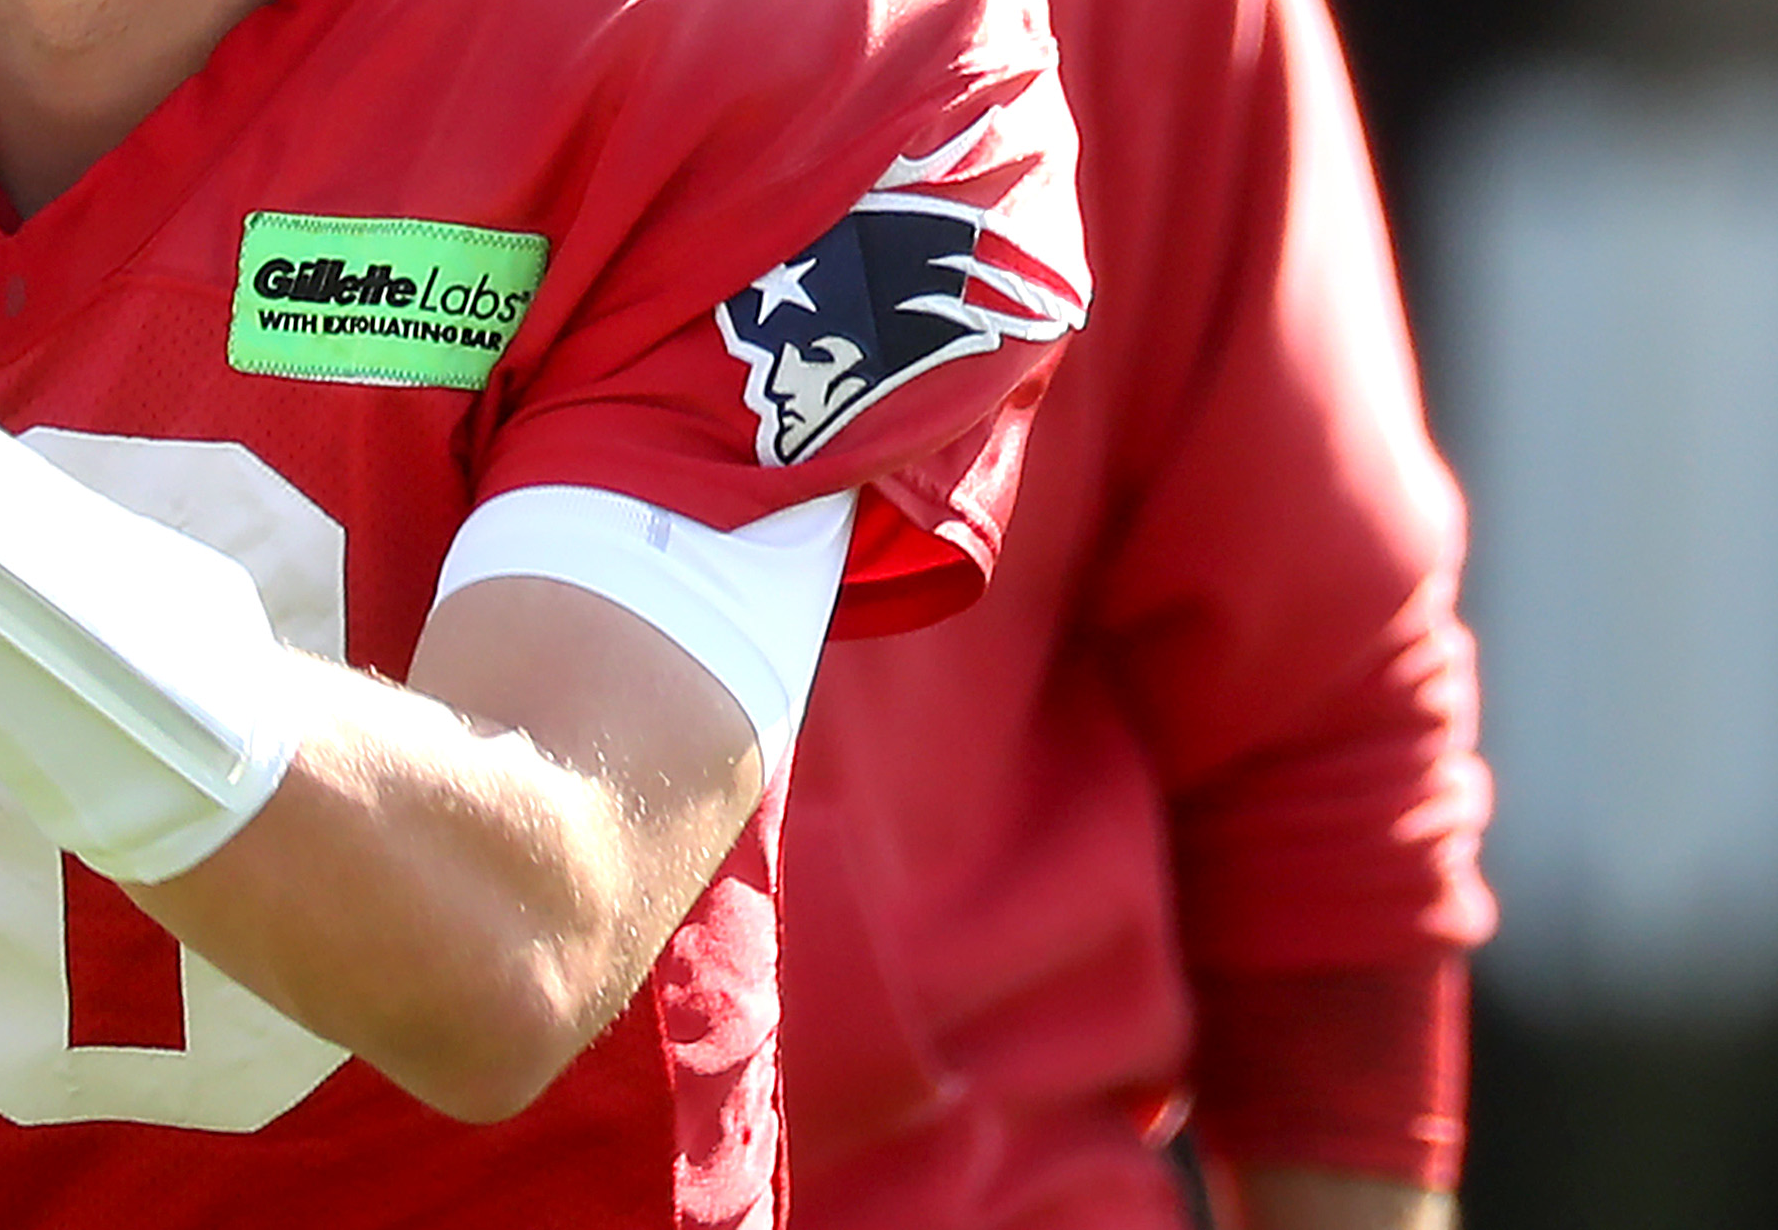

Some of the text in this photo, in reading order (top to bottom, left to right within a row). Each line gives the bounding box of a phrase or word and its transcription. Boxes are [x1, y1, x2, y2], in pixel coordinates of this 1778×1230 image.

[253, 258, 417, 306] Gillette
[258, 311, 318, 335] WITH
[460, 330, 503, 352] BAR
